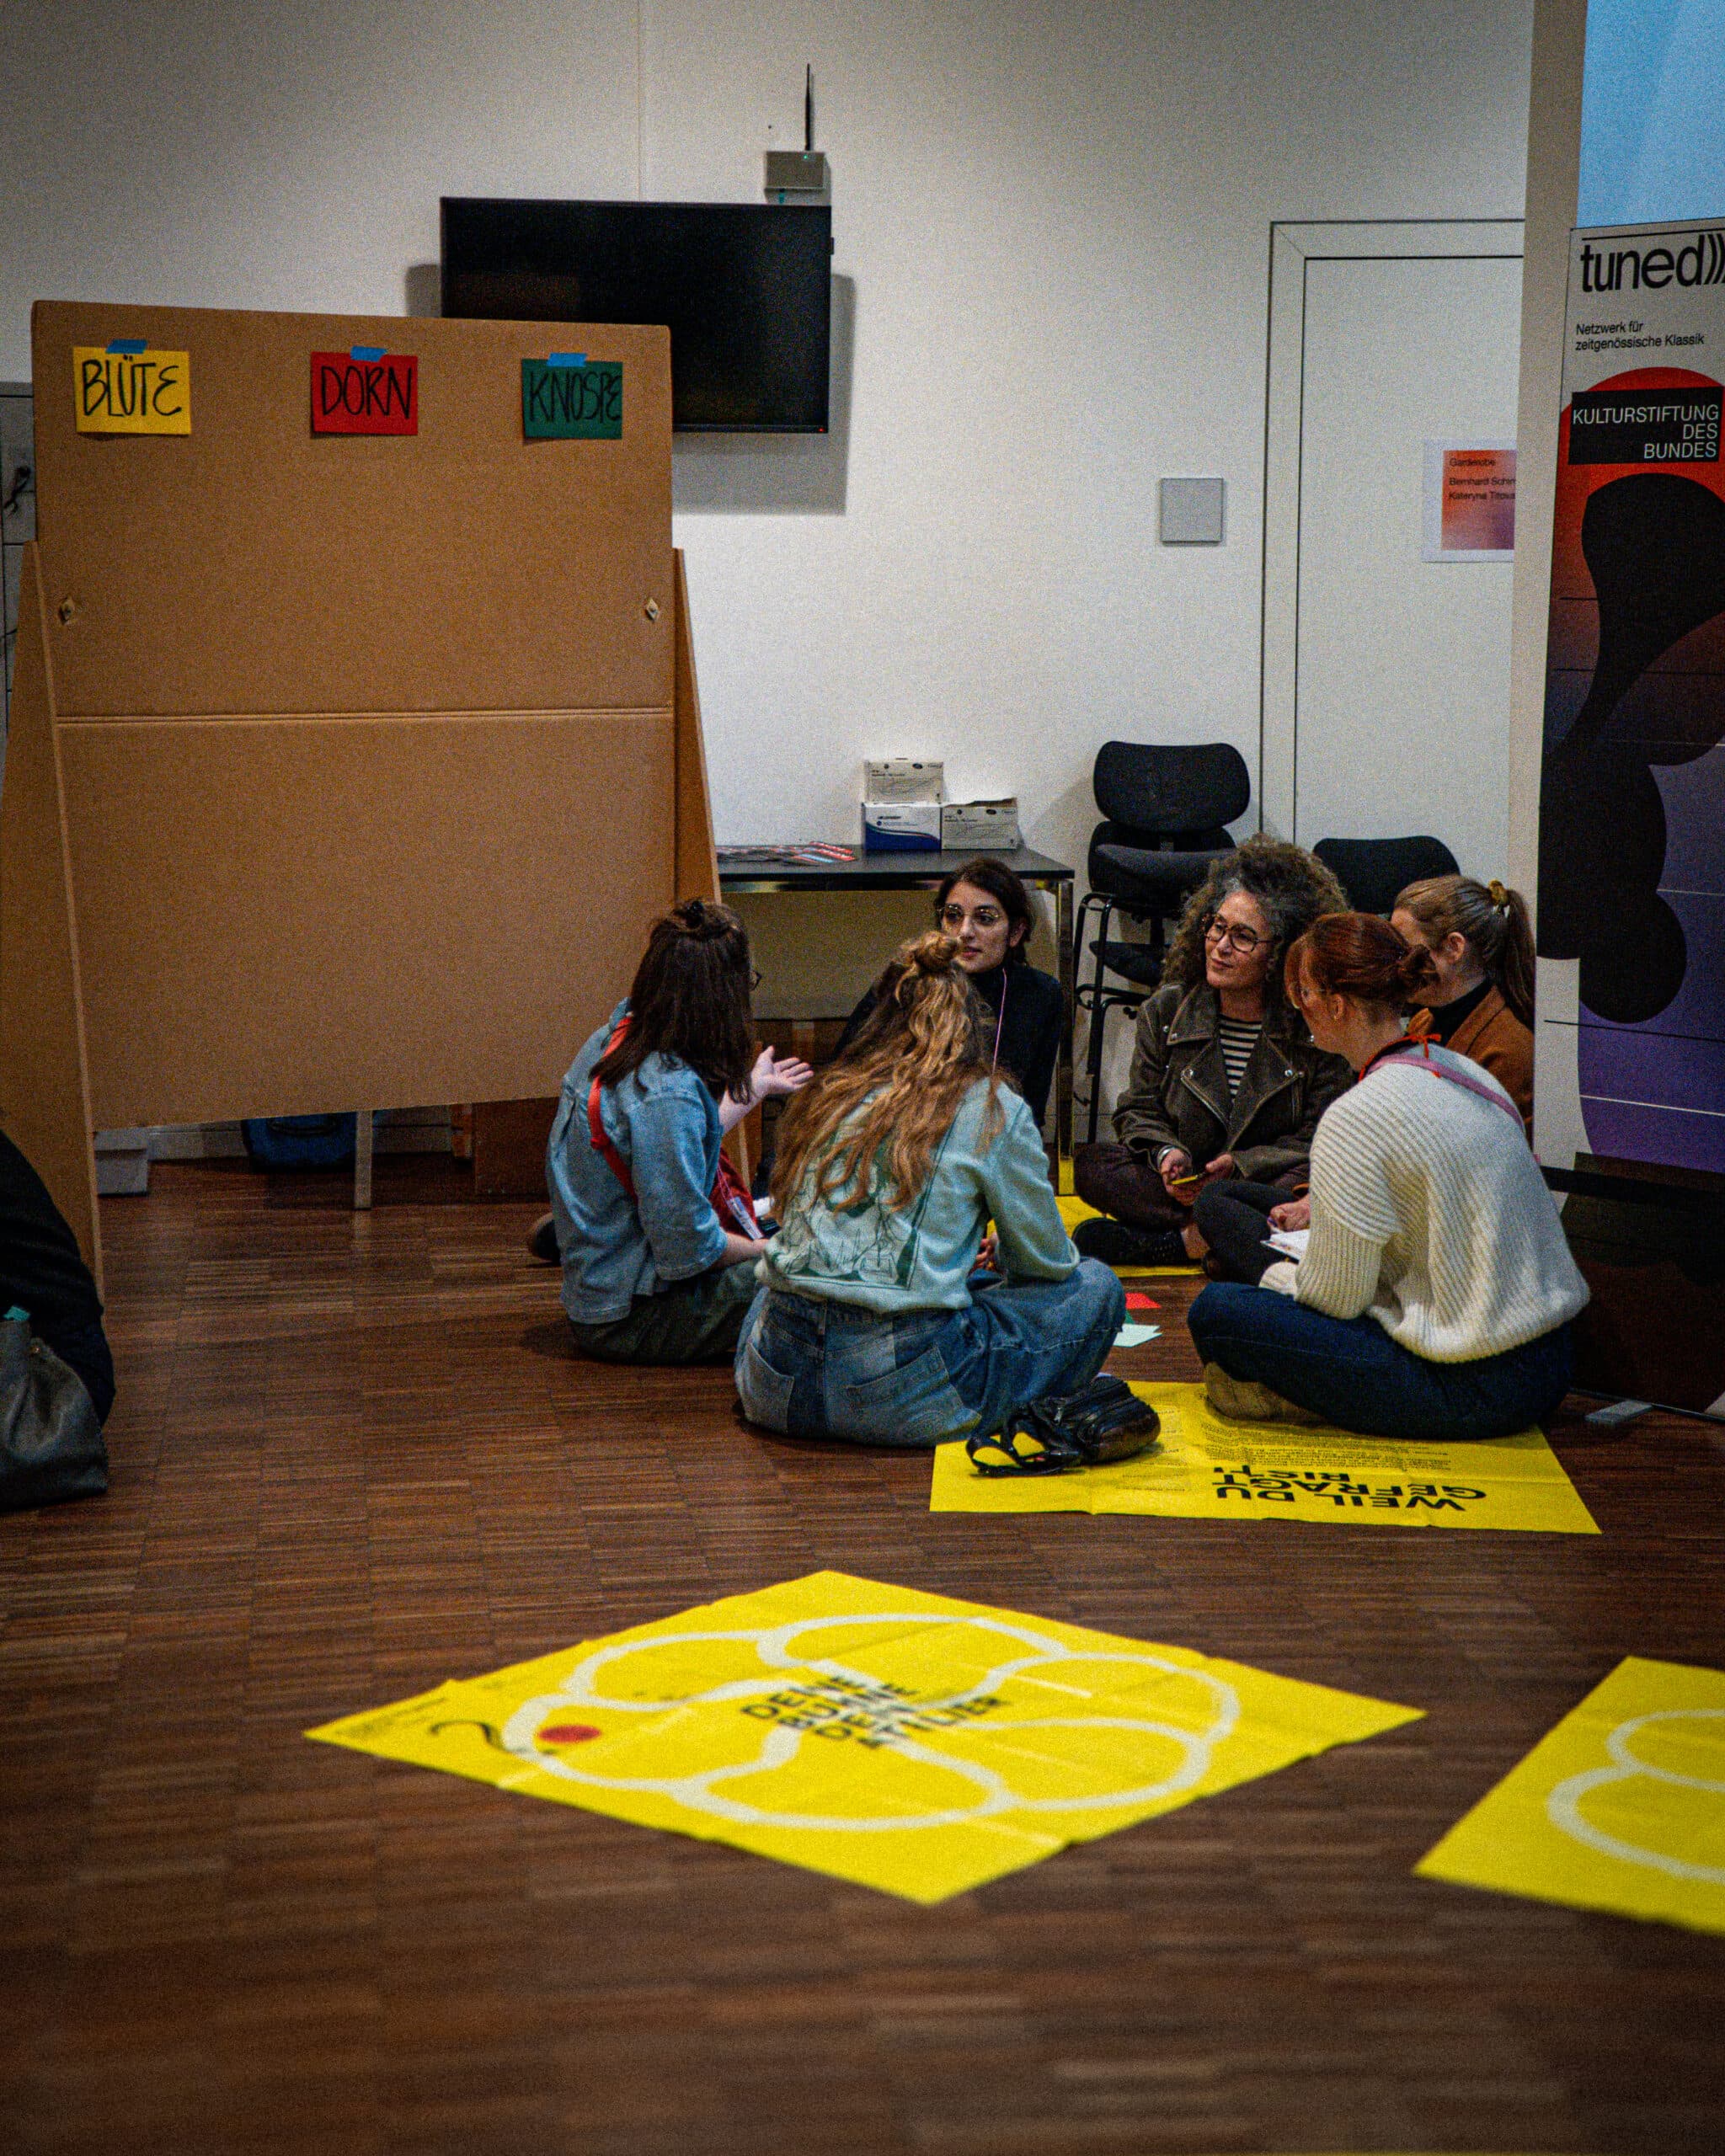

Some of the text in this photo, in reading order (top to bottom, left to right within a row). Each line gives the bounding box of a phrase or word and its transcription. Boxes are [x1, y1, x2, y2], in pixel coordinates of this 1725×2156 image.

[1576, 320, 1644, 335] Netzwerk für
[1575, 334, 1705, 352] zeitgenössische Klassik
[82, 354, 183, 417] BLÜTE
[321, 365, 413, 419] DORN
[529, 371, 622, 424] KNOSPE
[1573, 404, 1719, 424] KULTURSTIFTUNG
[1682, 423, 1718, 440] DES
[1643, 441, 1717, 459] BUNDES
[1212, 1474, 1487, 1500] GEFRAGT
[1216, 1486, 1466, 1512] WEIL DU
